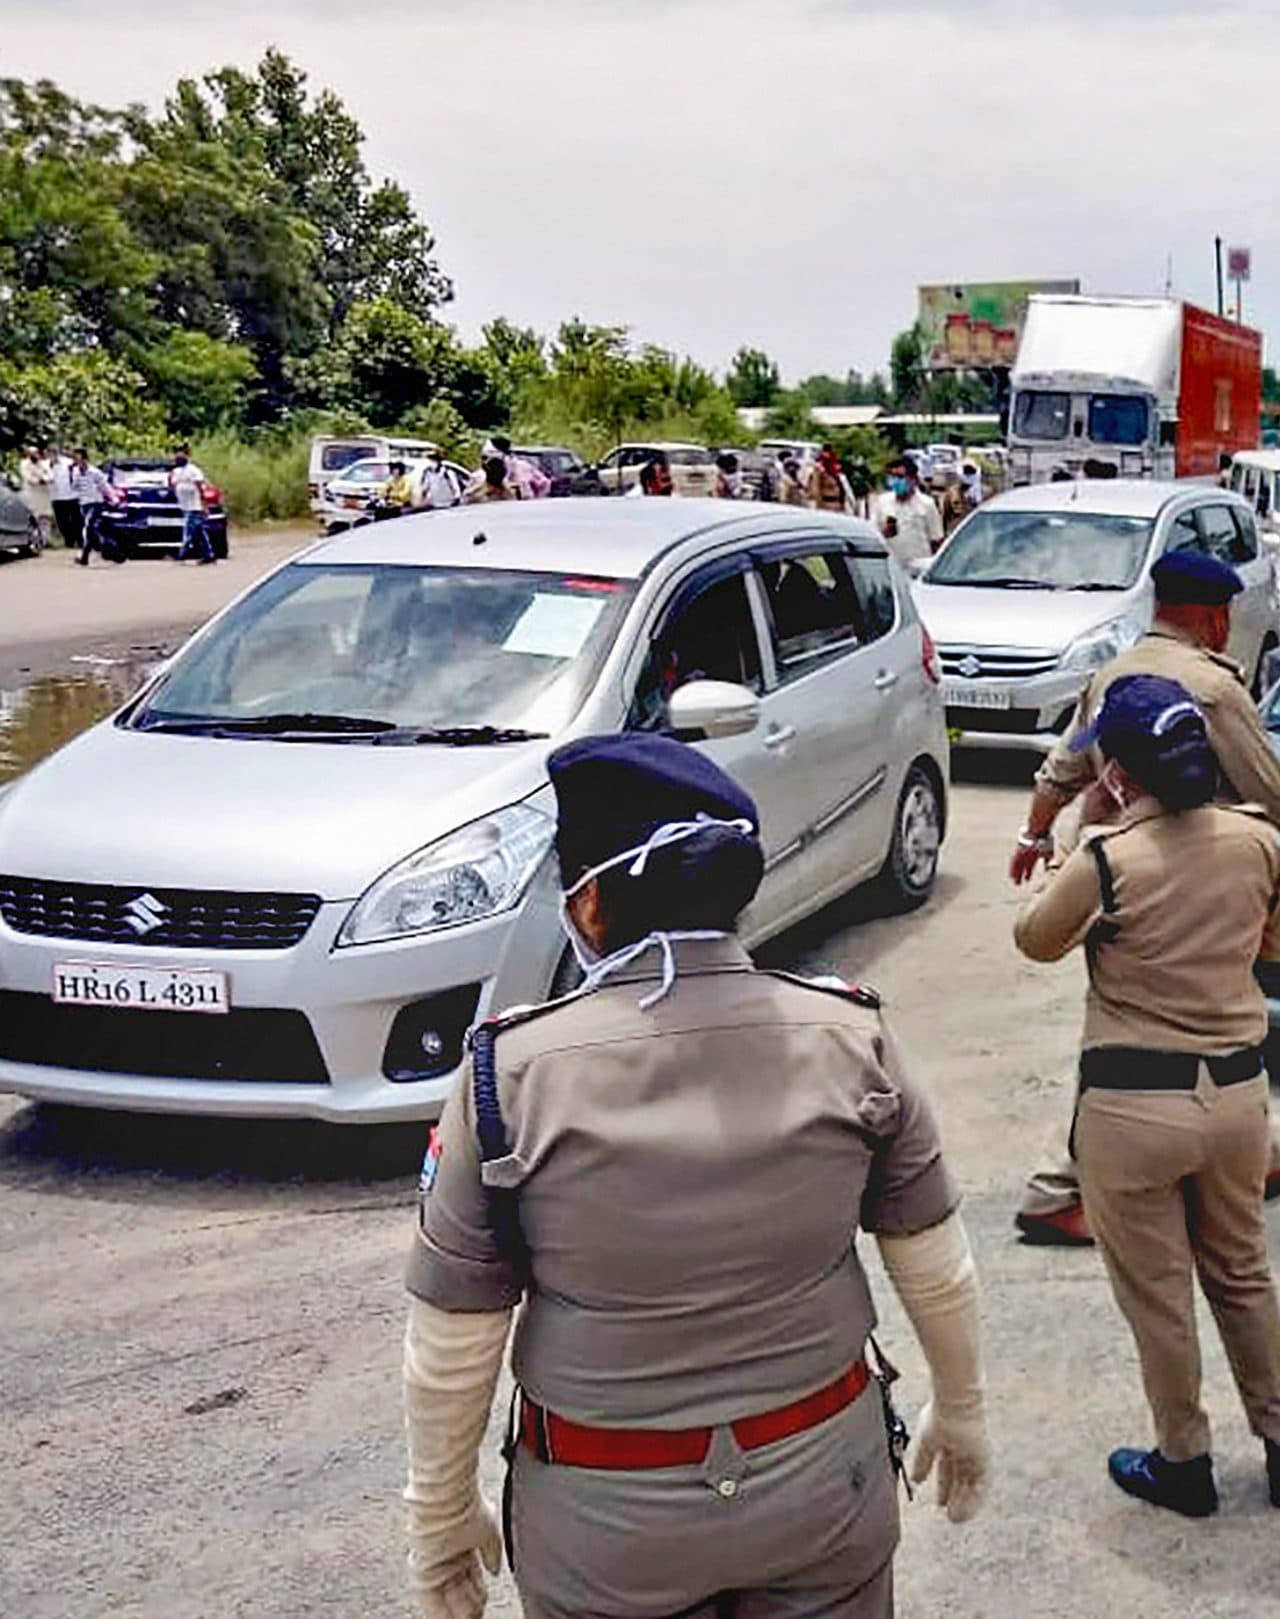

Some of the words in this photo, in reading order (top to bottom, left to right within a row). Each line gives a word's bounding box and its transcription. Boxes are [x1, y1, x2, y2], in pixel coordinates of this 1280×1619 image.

[58, 975, 131, 1002] HR16
[139, 980, 157, 1003] L
[162, 982, 220, 1007] 4311
